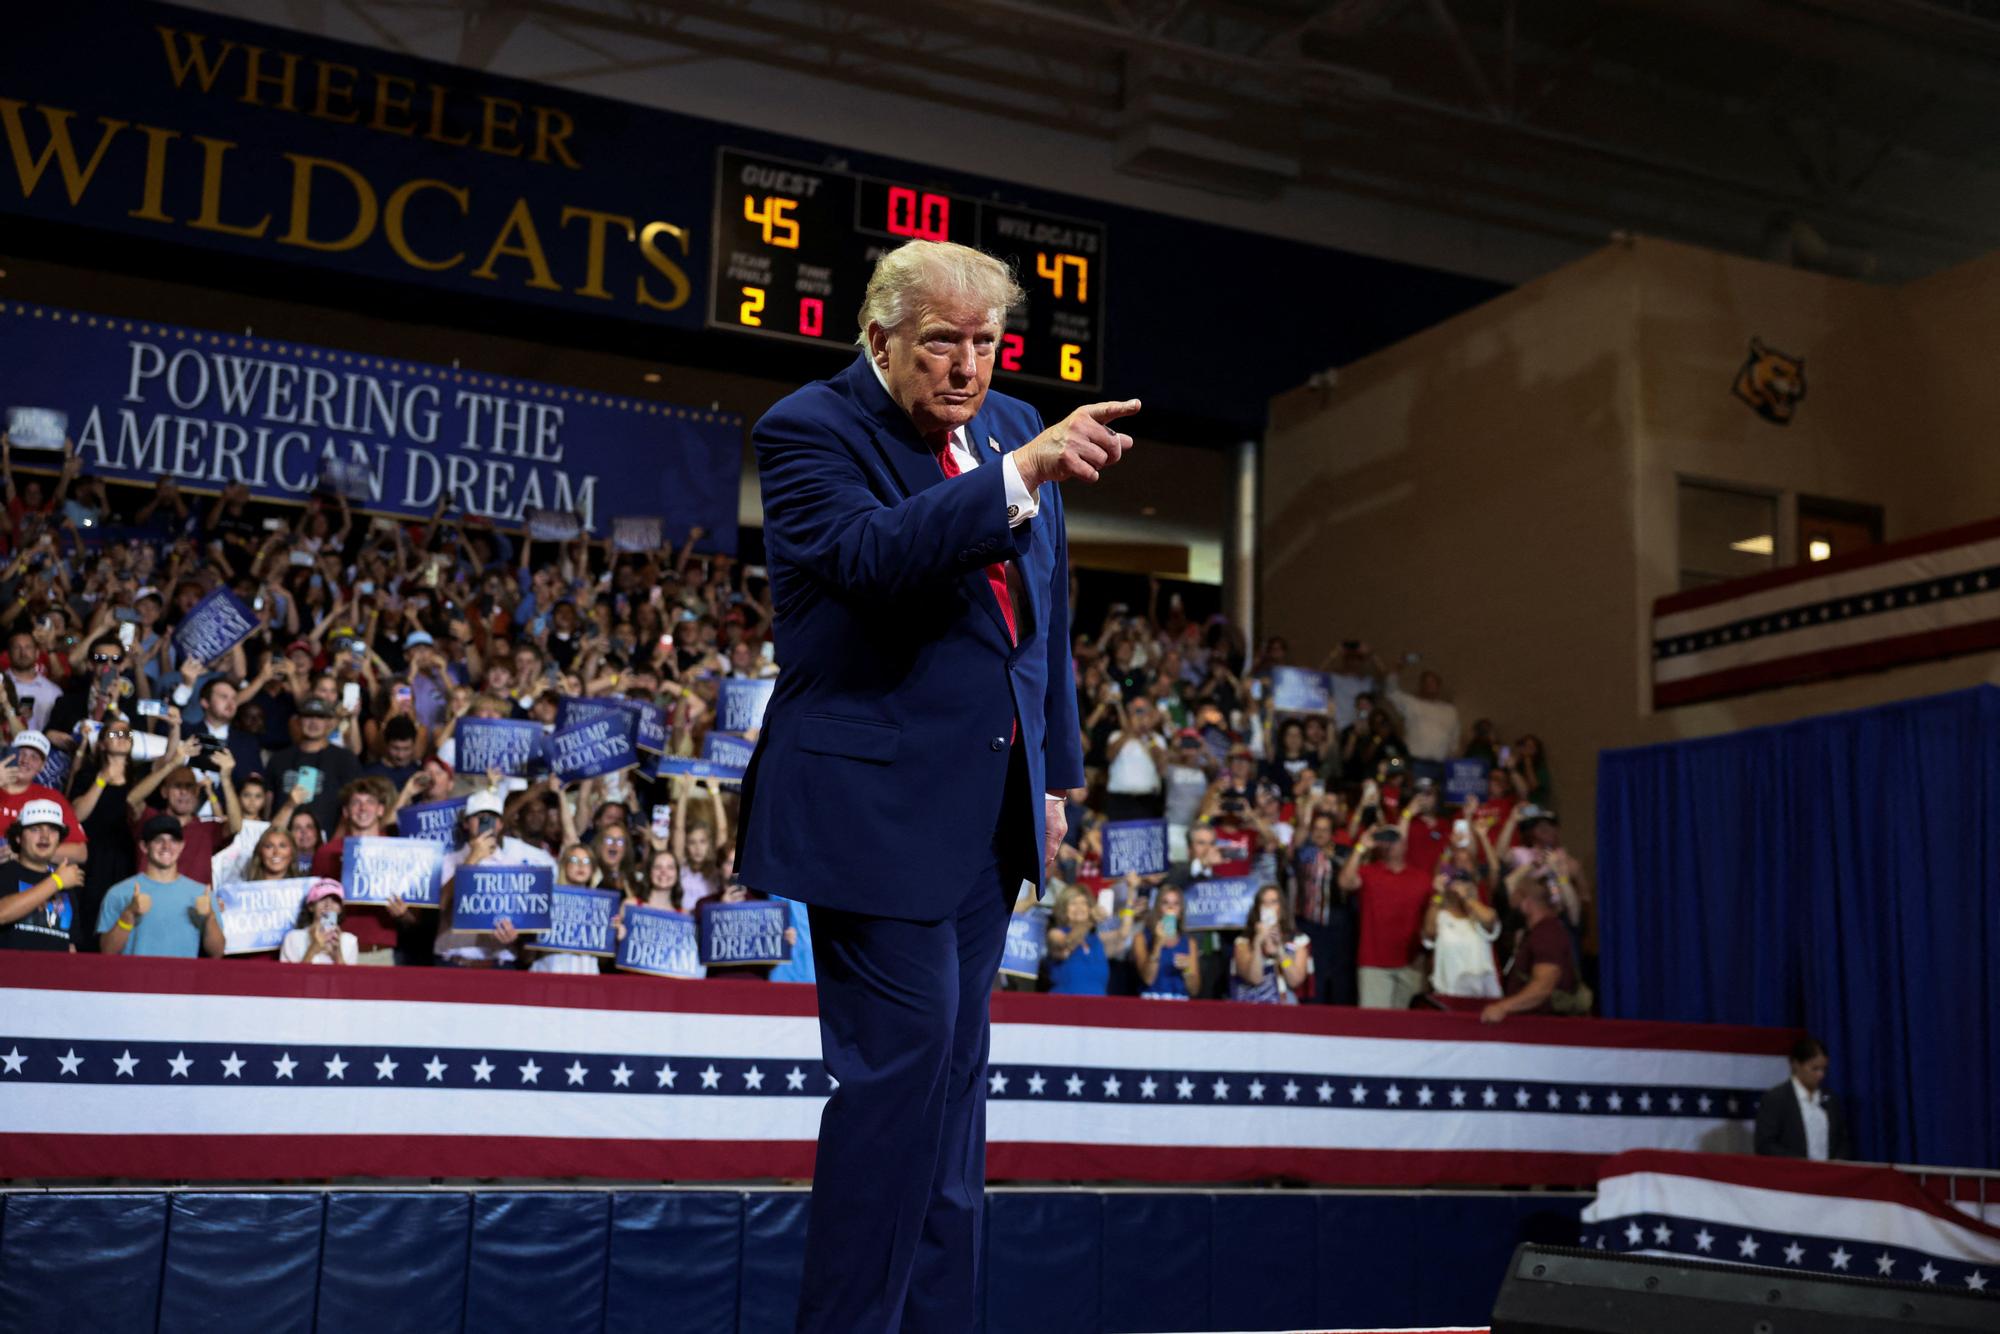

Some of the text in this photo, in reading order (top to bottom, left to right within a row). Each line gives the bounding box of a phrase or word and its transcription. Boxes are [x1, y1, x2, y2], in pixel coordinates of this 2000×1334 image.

[155, 24, 582, 169] WHEELER
[741, 163, 823, 198] GUEST
[0, 98, 691, 311] WILDCATS
[744, 193, 800, 249] 45
[1036, 250, 1089, 304] 47
[740, 286, 765, 327] 2
[798, 297, 824, 337] 0
[999, 332, 1025, 372] 2
[1059, 342, 1083, 382] 6
[123, 341, 564, 464] POWERING THE
[75, 405, 391, 501] AMERICAN
[404, 448, 599, 533] DREAM
[552, 734, 631, 775] ACCOUNTS
[555, 720, 610, 754] TRUMP
[351, 873, 431, 902] DREAM
[473, 873, 536, 893] TRUMP
[458, 893, 549, 915] ACCOUNTS
[626, 939, 698, 976] DREAM
[711, 935, 782, 961] DREAM
